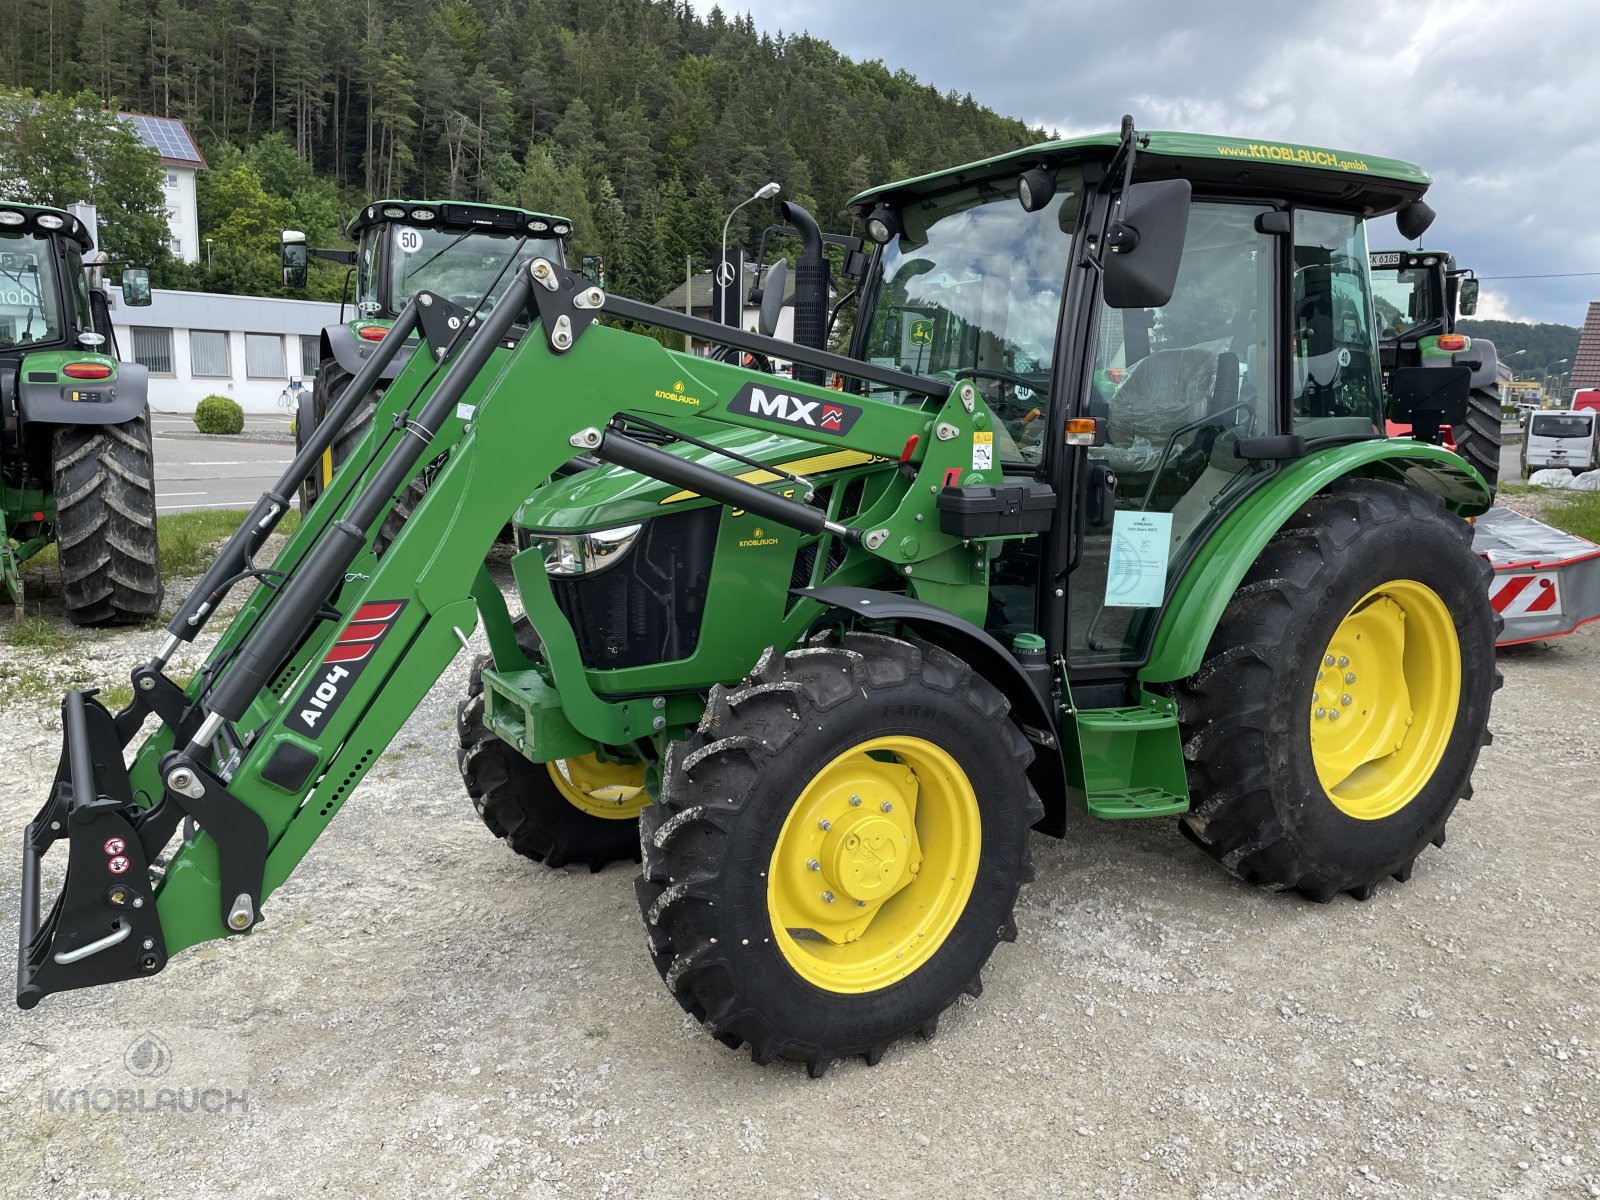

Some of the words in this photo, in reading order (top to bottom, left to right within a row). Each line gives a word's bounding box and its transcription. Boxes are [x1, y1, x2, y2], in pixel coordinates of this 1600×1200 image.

[1218, 144, 1368, 171] www.KNOBLAUCH.gmbh
[402, 232, 417, 249] 50
[1379, 254, 1399, 264] 6185
[655, 389, 700, 406] KNOBLAUCH
[750, 387, 820, 426] MX
[739, 537, 779, 548] KNOBLAUCH
